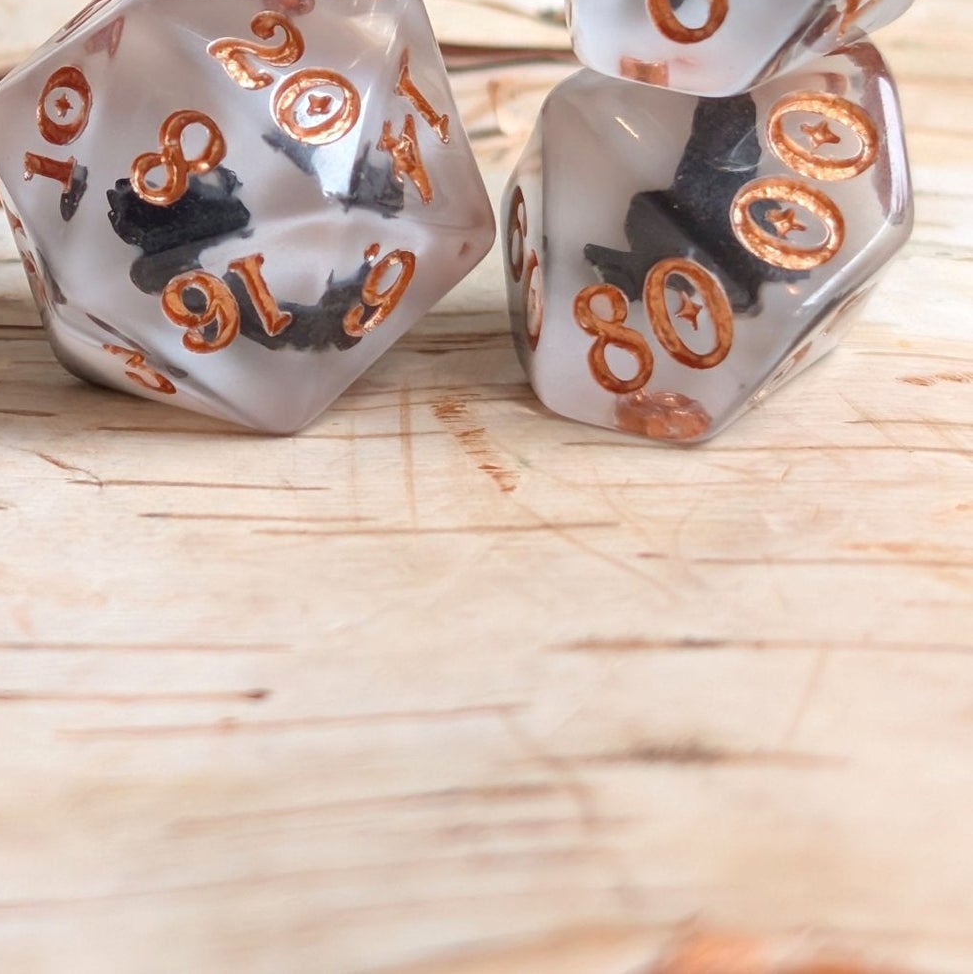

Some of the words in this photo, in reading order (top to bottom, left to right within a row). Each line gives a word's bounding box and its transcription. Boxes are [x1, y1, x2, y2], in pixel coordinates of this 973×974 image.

[207, 10, 361, 146] 20
[130, 109, 227, 207] 8
[573, 257, 734, 394] 80
